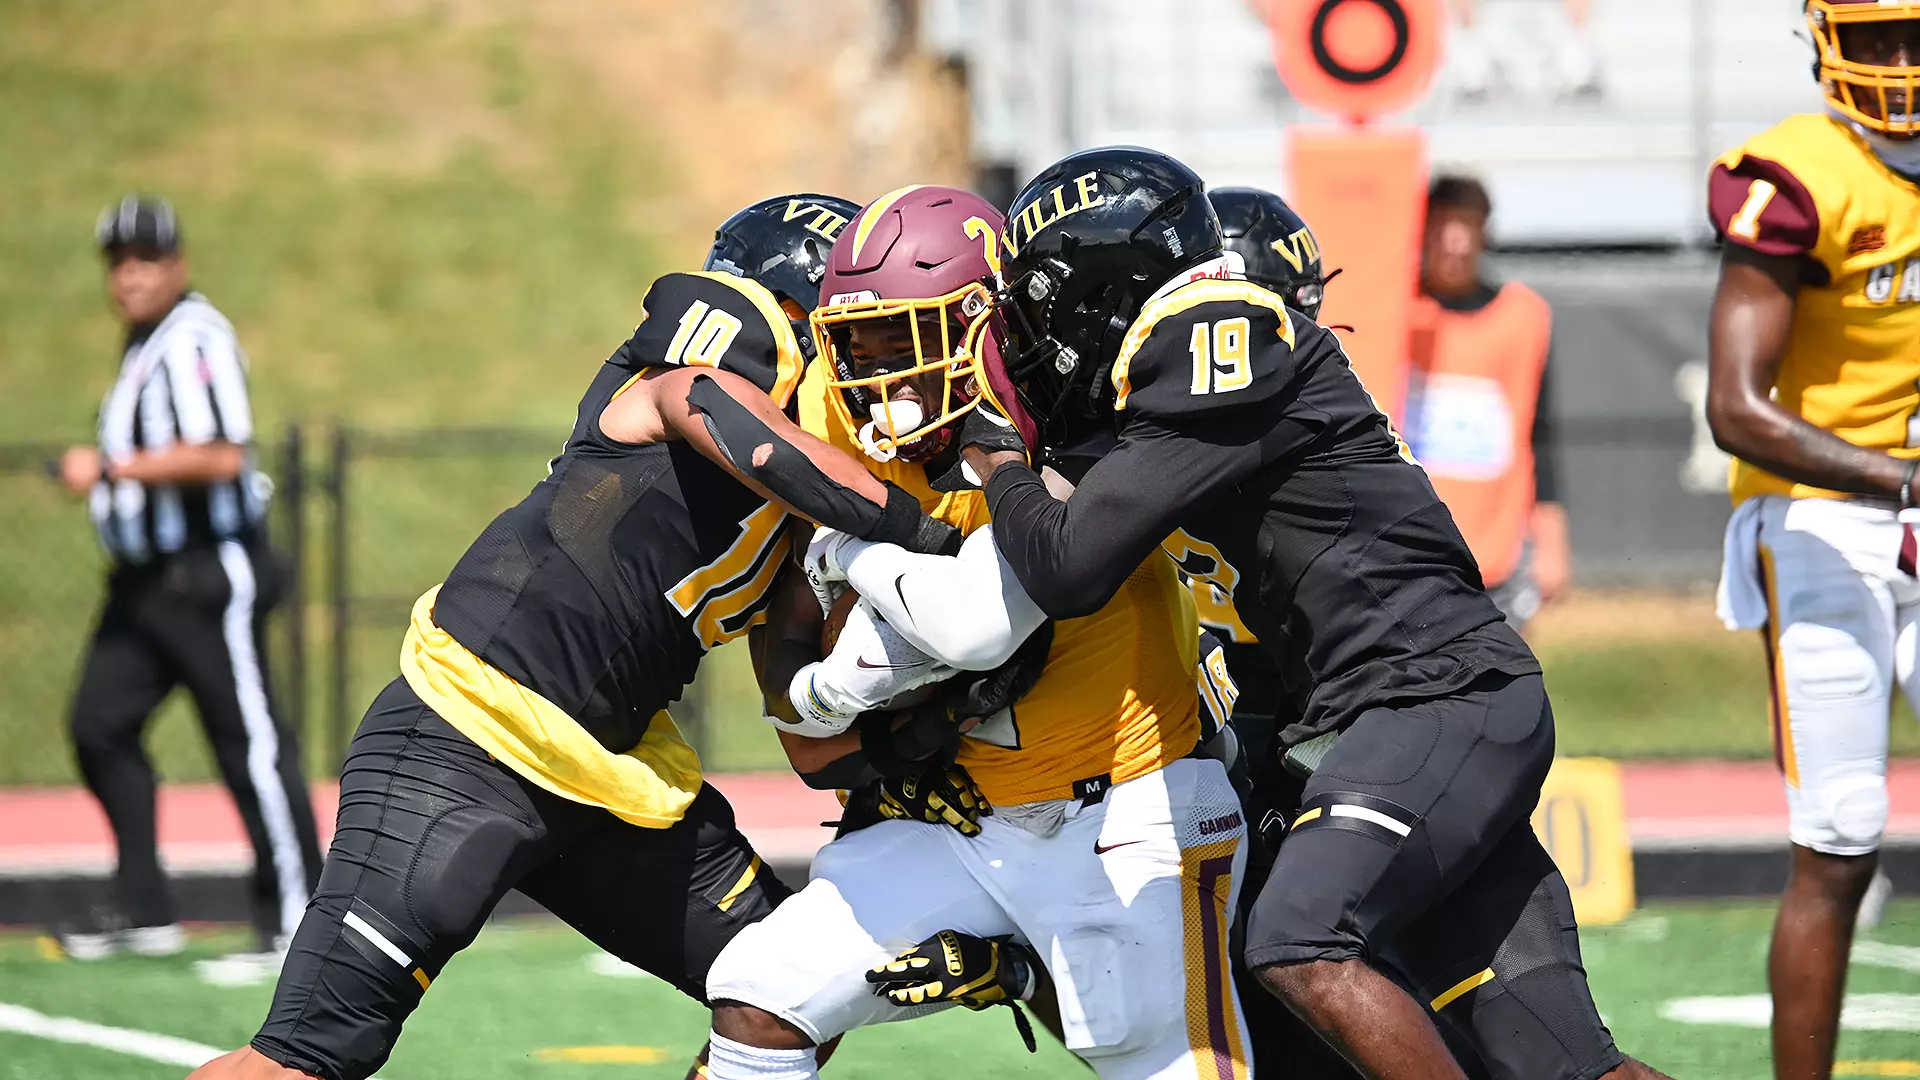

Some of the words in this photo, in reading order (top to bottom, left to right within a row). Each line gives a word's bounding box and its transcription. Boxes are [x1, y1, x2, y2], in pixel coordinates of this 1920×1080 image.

[1001, 169, 1104, 260] VILLE
[1728, 179, 1778, 243] 1
[664, 299, 743, 369] 10
[1189, 317, 1254, 396] 19
[1084, 780, 1101, 795] M
[1198, 809, 1243, 836] GANNON
